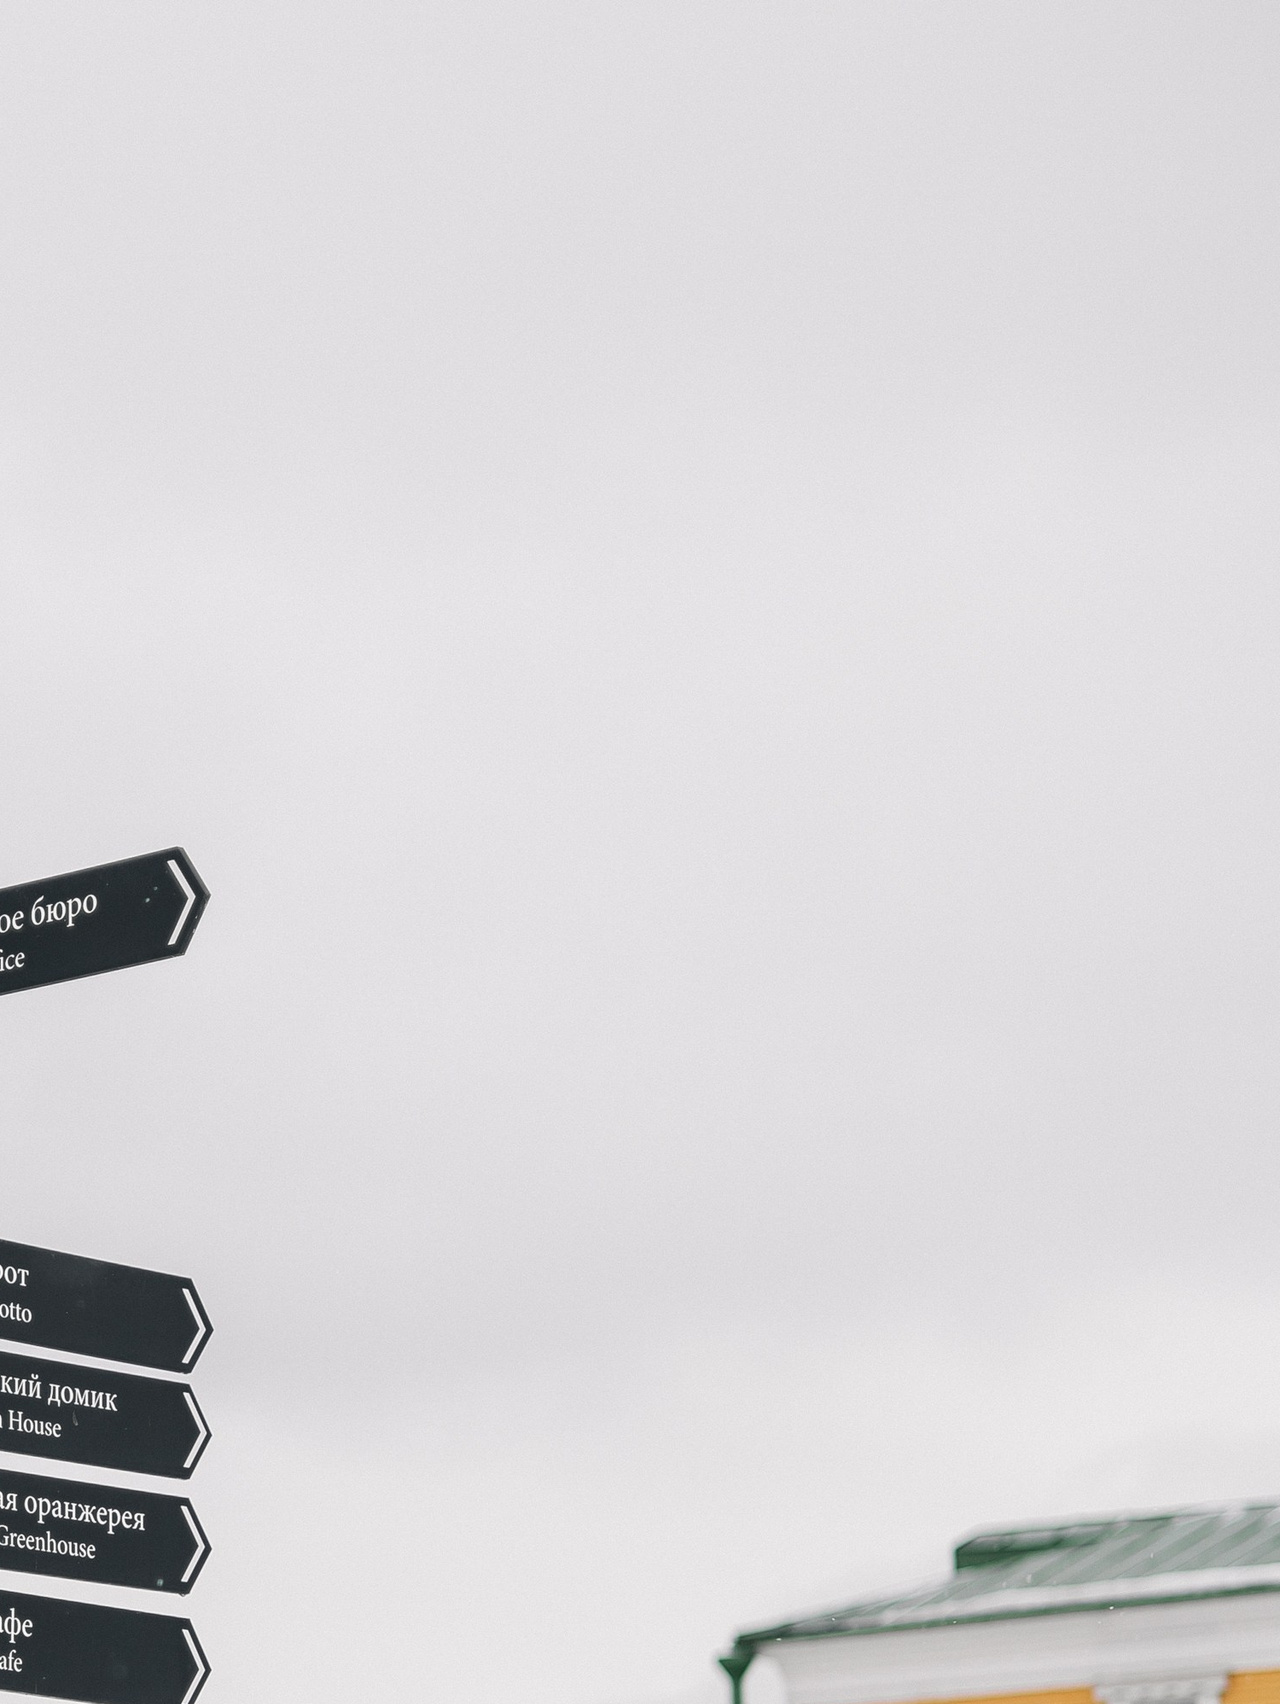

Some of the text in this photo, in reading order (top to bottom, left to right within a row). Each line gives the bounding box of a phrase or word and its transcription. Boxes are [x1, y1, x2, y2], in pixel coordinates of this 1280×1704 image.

[30, 893, 98, 928] бюро
[47, 1383, 118, 1412] домик
[7, 1409, 62, 1438] House
[23, 1495, 146, 1535] оранжерея
